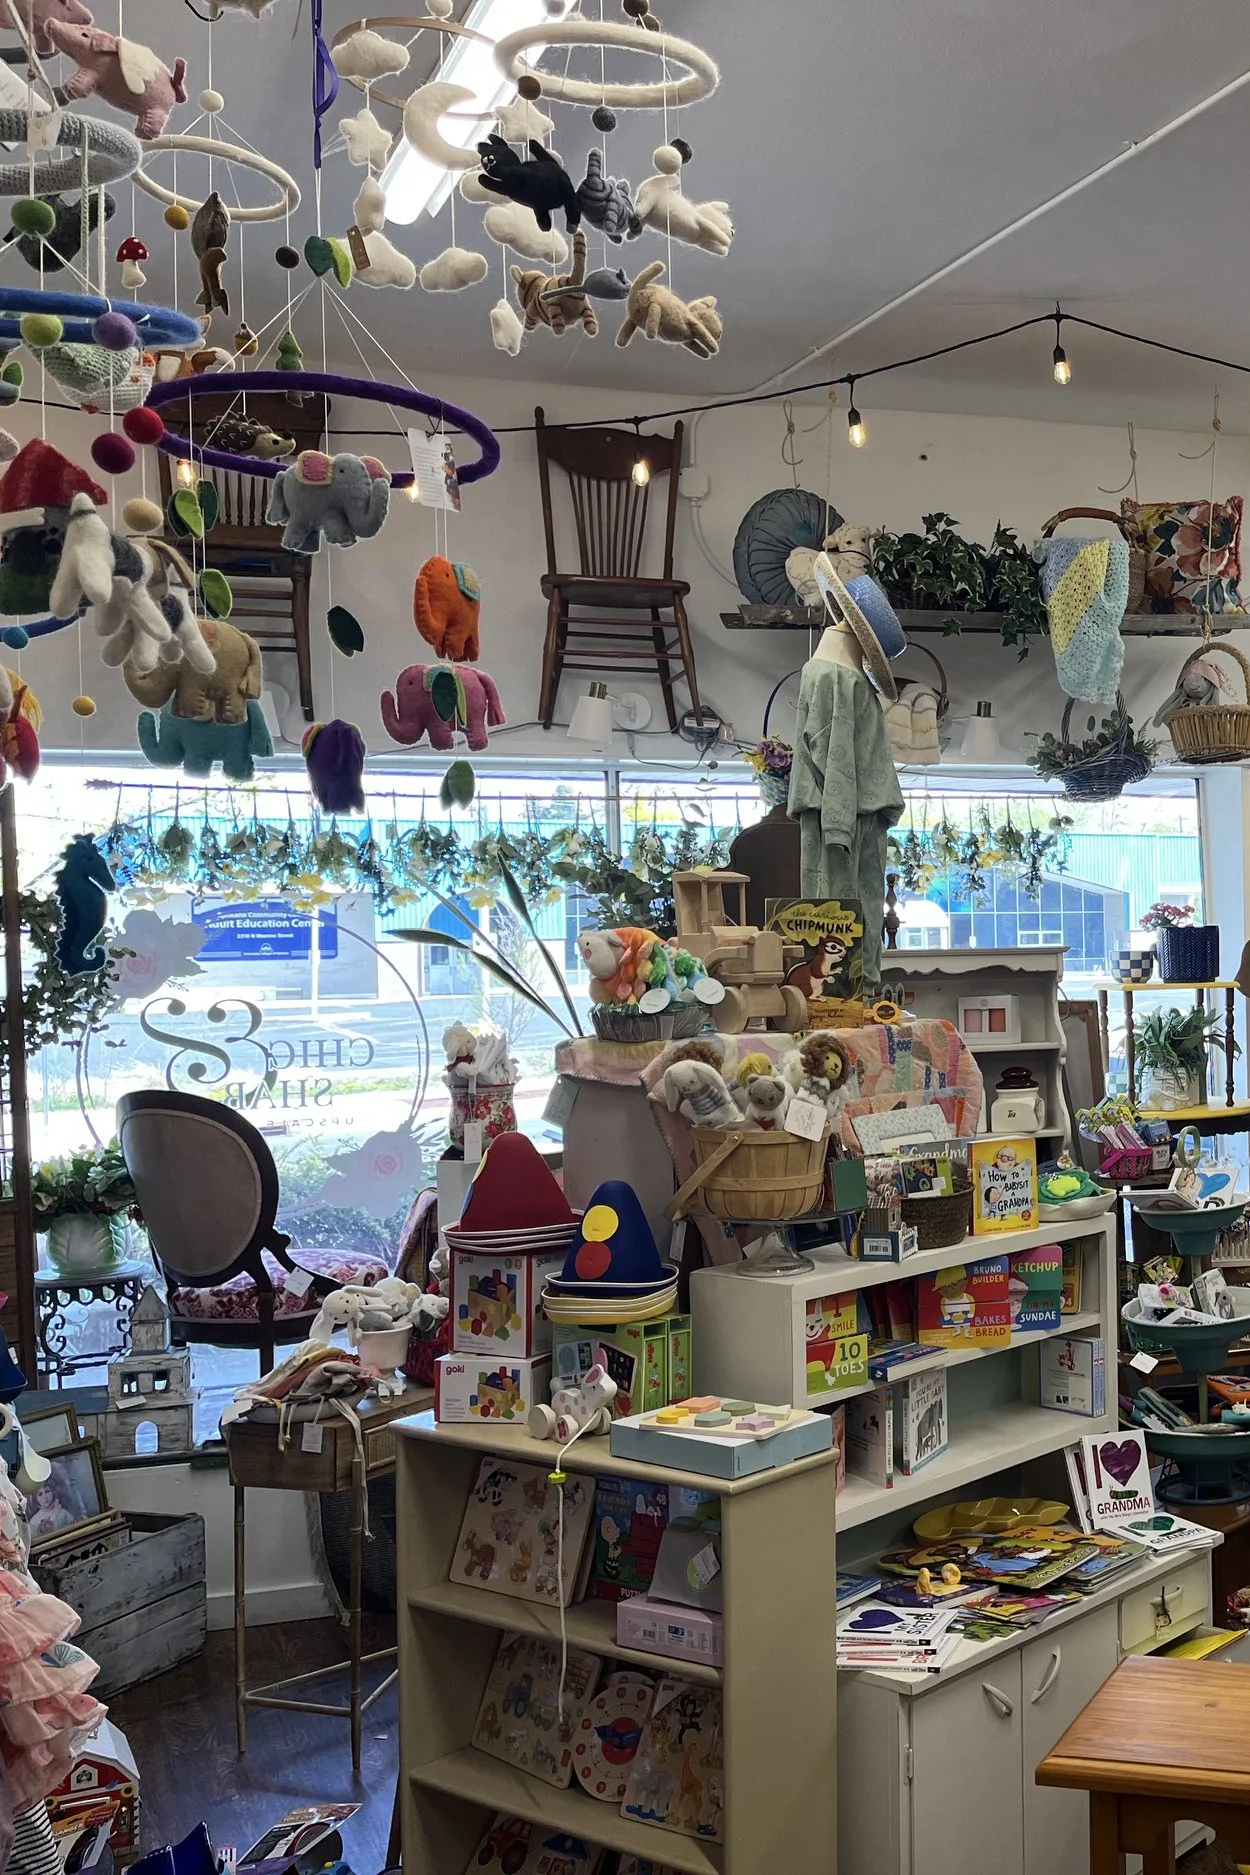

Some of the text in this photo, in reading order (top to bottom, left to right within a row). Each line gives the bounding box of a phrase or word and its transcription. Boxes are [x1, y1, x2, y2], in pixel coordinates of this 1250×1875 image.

[236, 918, 290, 929] Education
[787, 919, 854, 934] CHIPMUNK
[1003, 1179, 1029, 1192] BABYSIT
[997, 1196, 1030, 1212] GRANDPA
[458, 1255, 474, 1265] goki
[973, 1264, 1002, 1274] BRUNO
[1011, 1261, 1059, 1273] KETCHUP
[972, 1274, 1004, 1285] BUILDER
[1026, 1300, 1039, 1310] ON
[974, 1313, 1007, 1327] BAKES
[1019, 1310, 1057, 1323] SUNDAE
[831, 1318, 855, 1333] SMILE
[975, 1327, 1006, 1338] BREAD
[838, 1341, 862, 1361] 10
[445, 1364, 465, 1375] goki
[834, 1359, 865, 1378] TOES
[911, 1385, 945, 1412] LITTLE BABY
[656, 1492, 667, 1505] 48
[1097, 1496, 1151, 1515] GRANDMA
[1150, 1527, 1206, 1545] GRANDPA
[620, 1586, 642, 1599] PUZZ
[906, 1612, 938, 1635] SISTER
